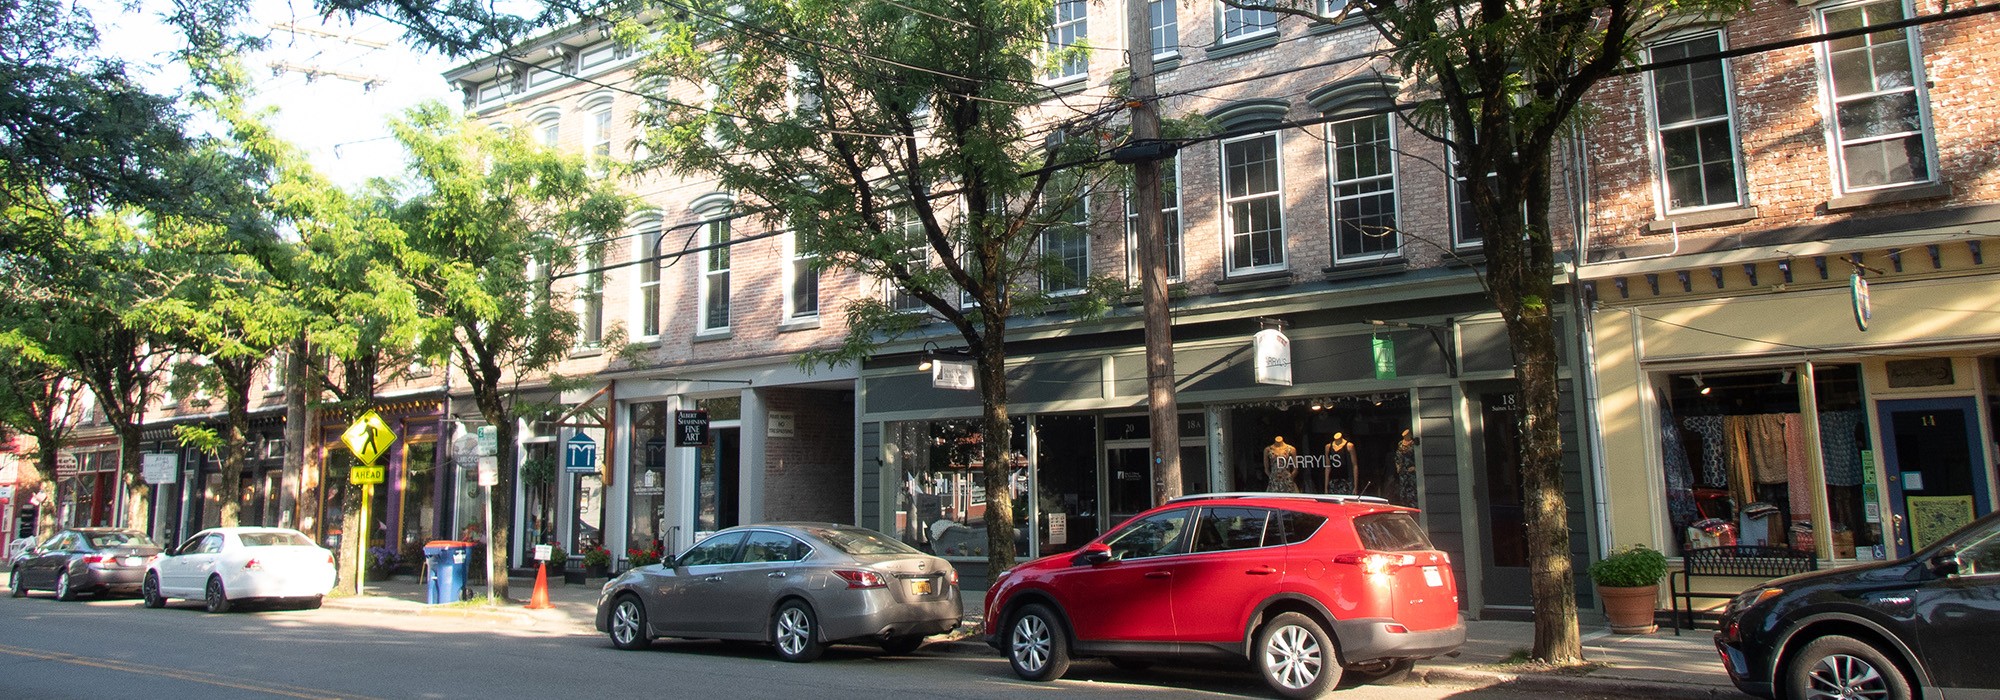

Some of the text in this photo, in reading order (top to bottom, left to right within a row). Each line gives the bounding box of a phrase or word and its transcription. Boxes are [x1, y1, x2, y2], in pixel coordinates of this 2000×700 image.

[1503, 394, 1515, 405] 18
[1921, 415, 1936, 427] 14
[685, 425, 700, 433] FINE
[1126, 424, 1134, 432] 20
[685, 433, 700, 441] ART
[1276, 454, 1342, 469] DARRYL'S
[355, 471, 381, 479] AHEAD
